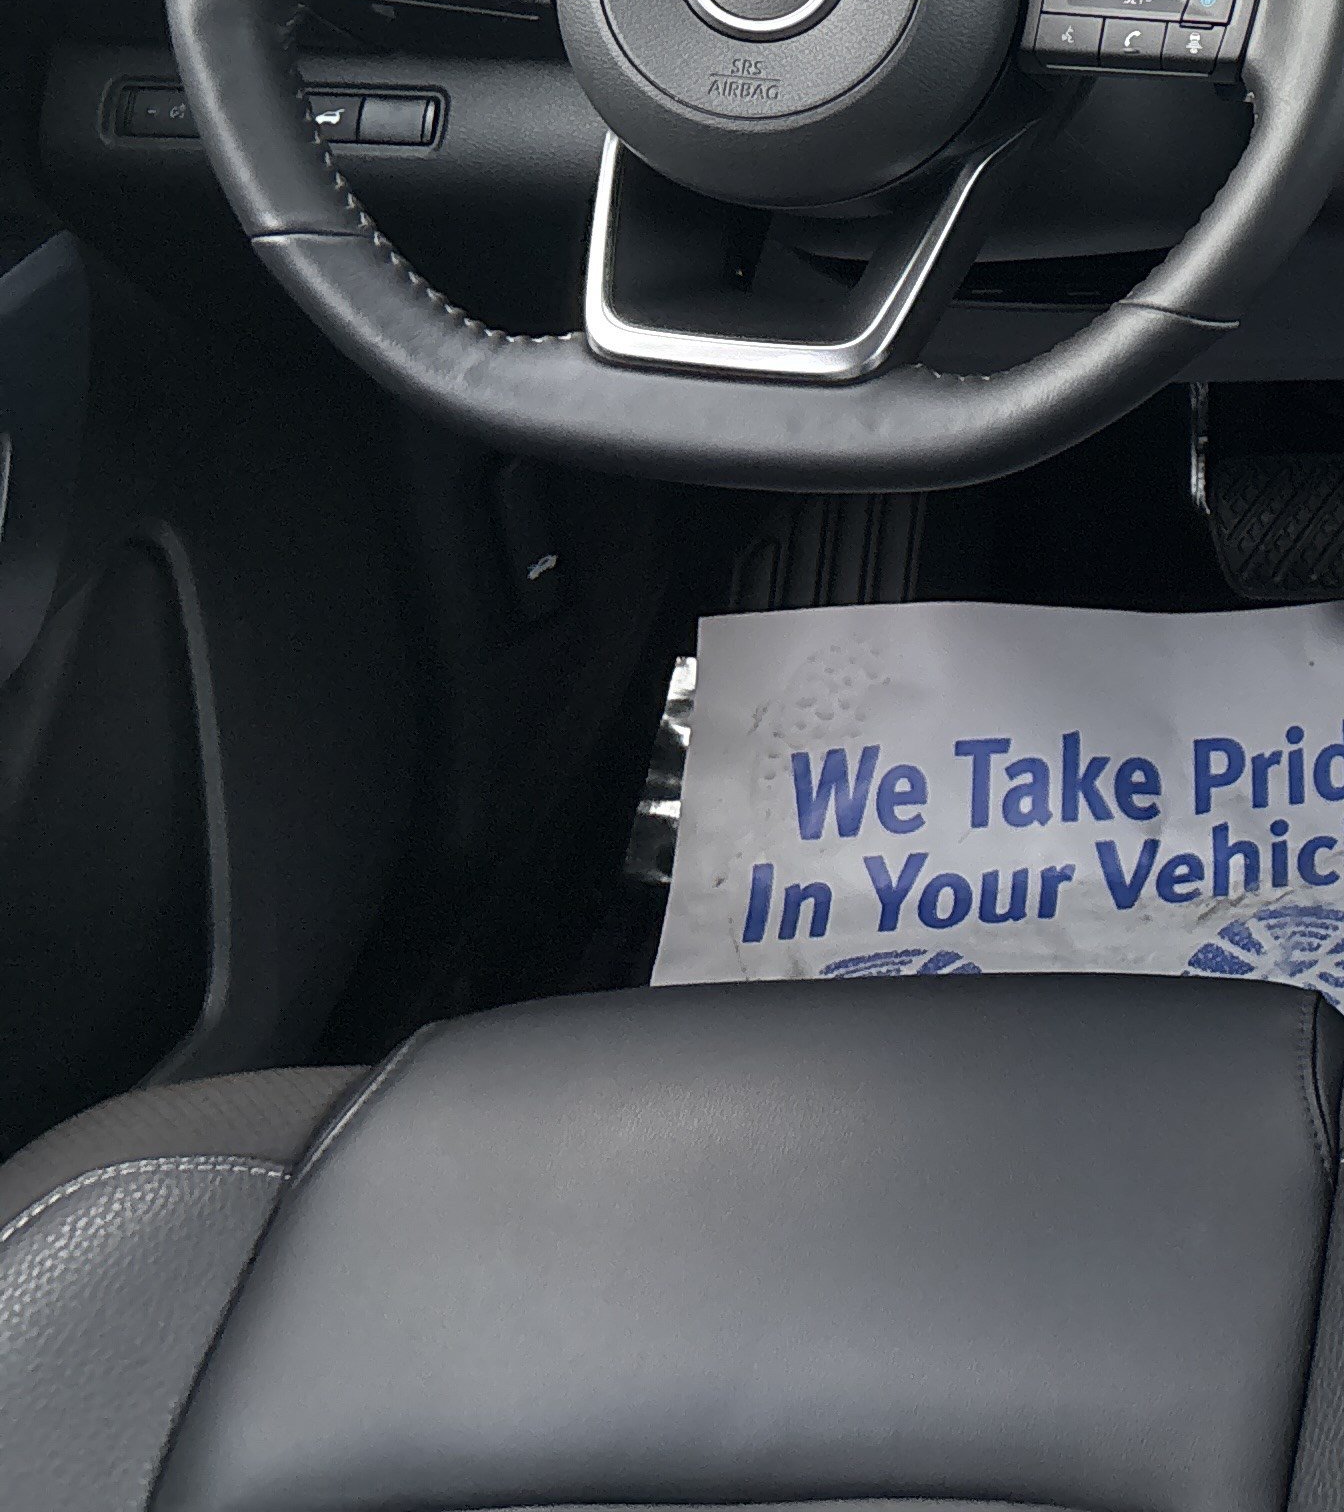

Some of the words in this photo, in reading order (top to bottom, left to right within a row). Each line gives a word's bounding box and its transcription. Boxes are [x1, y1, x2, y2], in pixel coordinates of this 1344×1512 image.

[706, 78, 780, 101] AIRBAG
[729, 57, 764, 76] SRS
[790, 743, 930, 842] We
[953, 729, 1163, 830] Take
[741, 862, 833, 944] In
[862, 851, 1077, 934] Your
